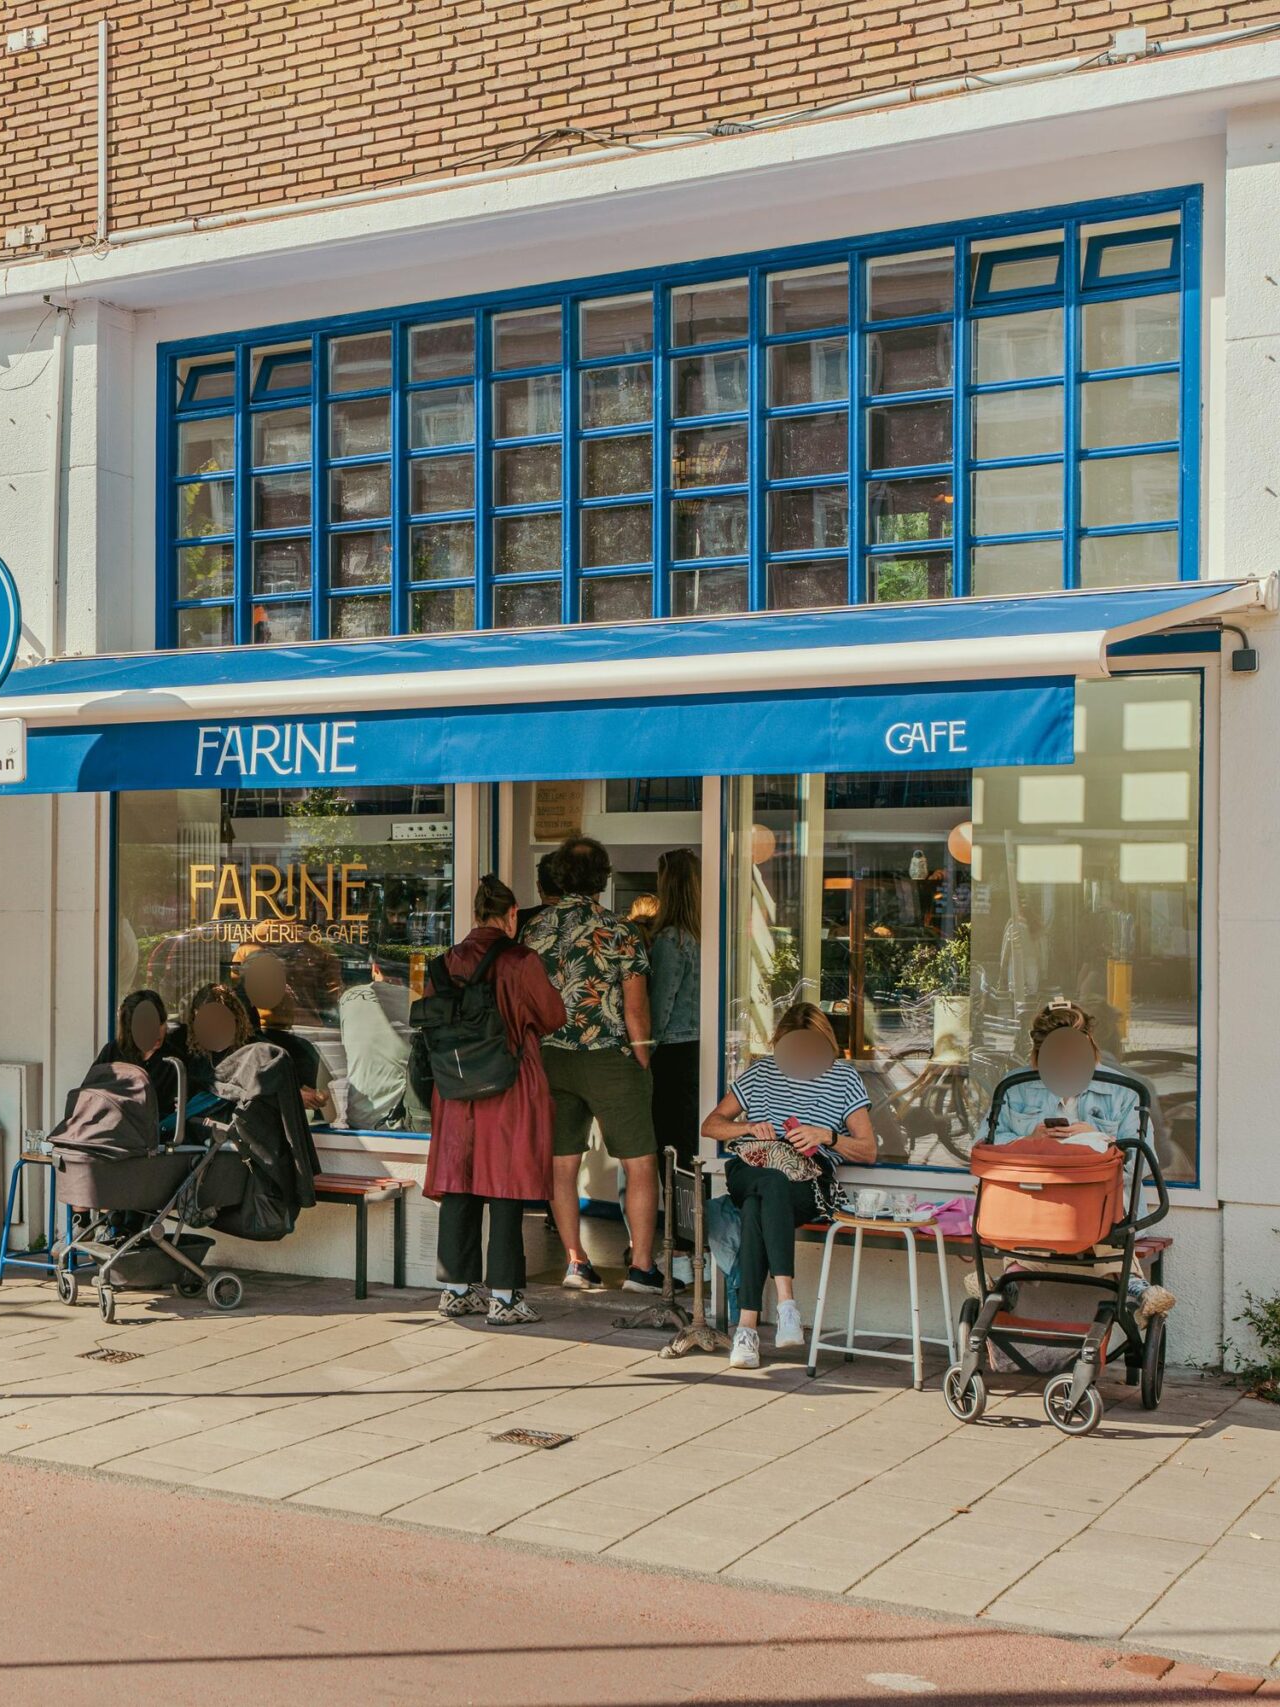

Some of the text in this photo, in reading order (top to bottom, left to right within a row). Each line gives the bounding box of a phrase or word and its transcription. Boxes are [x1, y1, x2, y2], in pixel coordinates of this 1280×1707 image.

[195, 720, 358, 776] FARINE
[884, 719, 969, 755] CAFE
[189, 863, 370, 921] FARINE
[189, 924, 305, 944] BOULANGERIE
[308, 924, 322, 944] &
